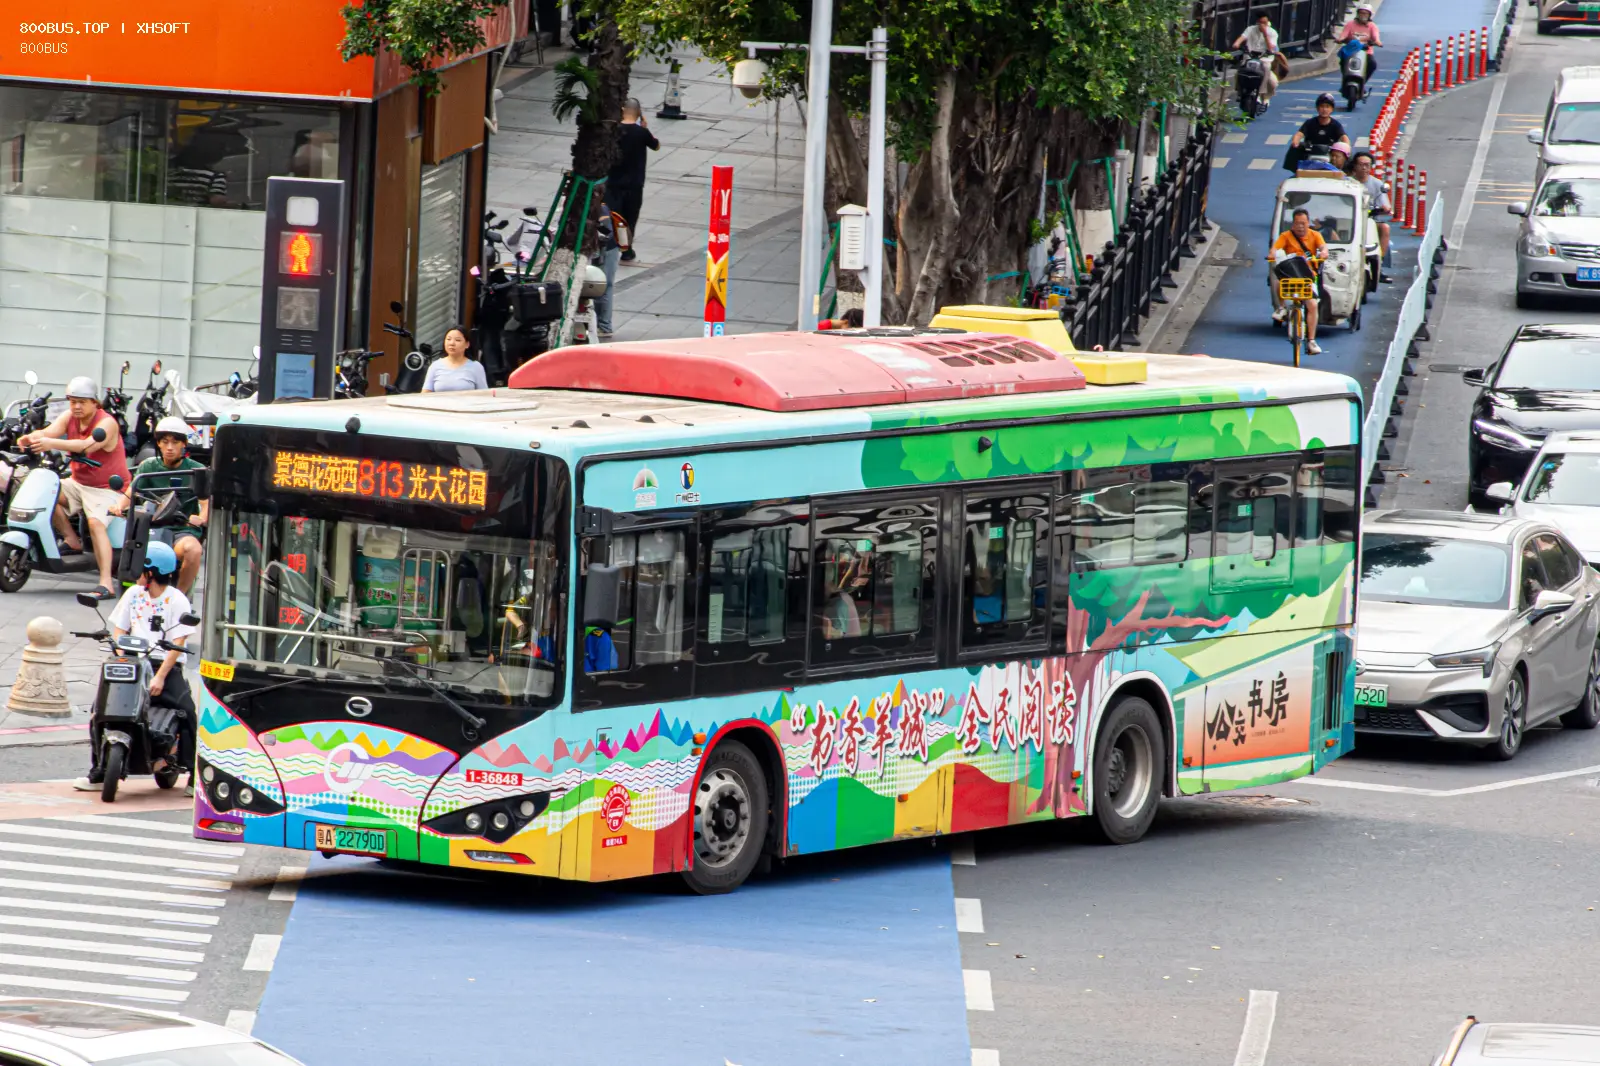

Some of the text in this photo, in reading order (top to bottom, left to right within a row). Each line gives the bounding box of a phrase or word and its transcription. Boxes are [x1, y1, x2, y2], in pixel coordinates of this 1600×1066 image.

[358, 458, 404, 498] 813
[408, 464, 487, 506] 光大花园
[955, 671, 1077, 753] 全民阅读
[1206, 671, 1290, 750] 公交书房
[1355, 687, 1385, 703] 7520
[469, 771, 519, 785] 1-36848
[317, 827, 385, 851] 粤A 22790D
